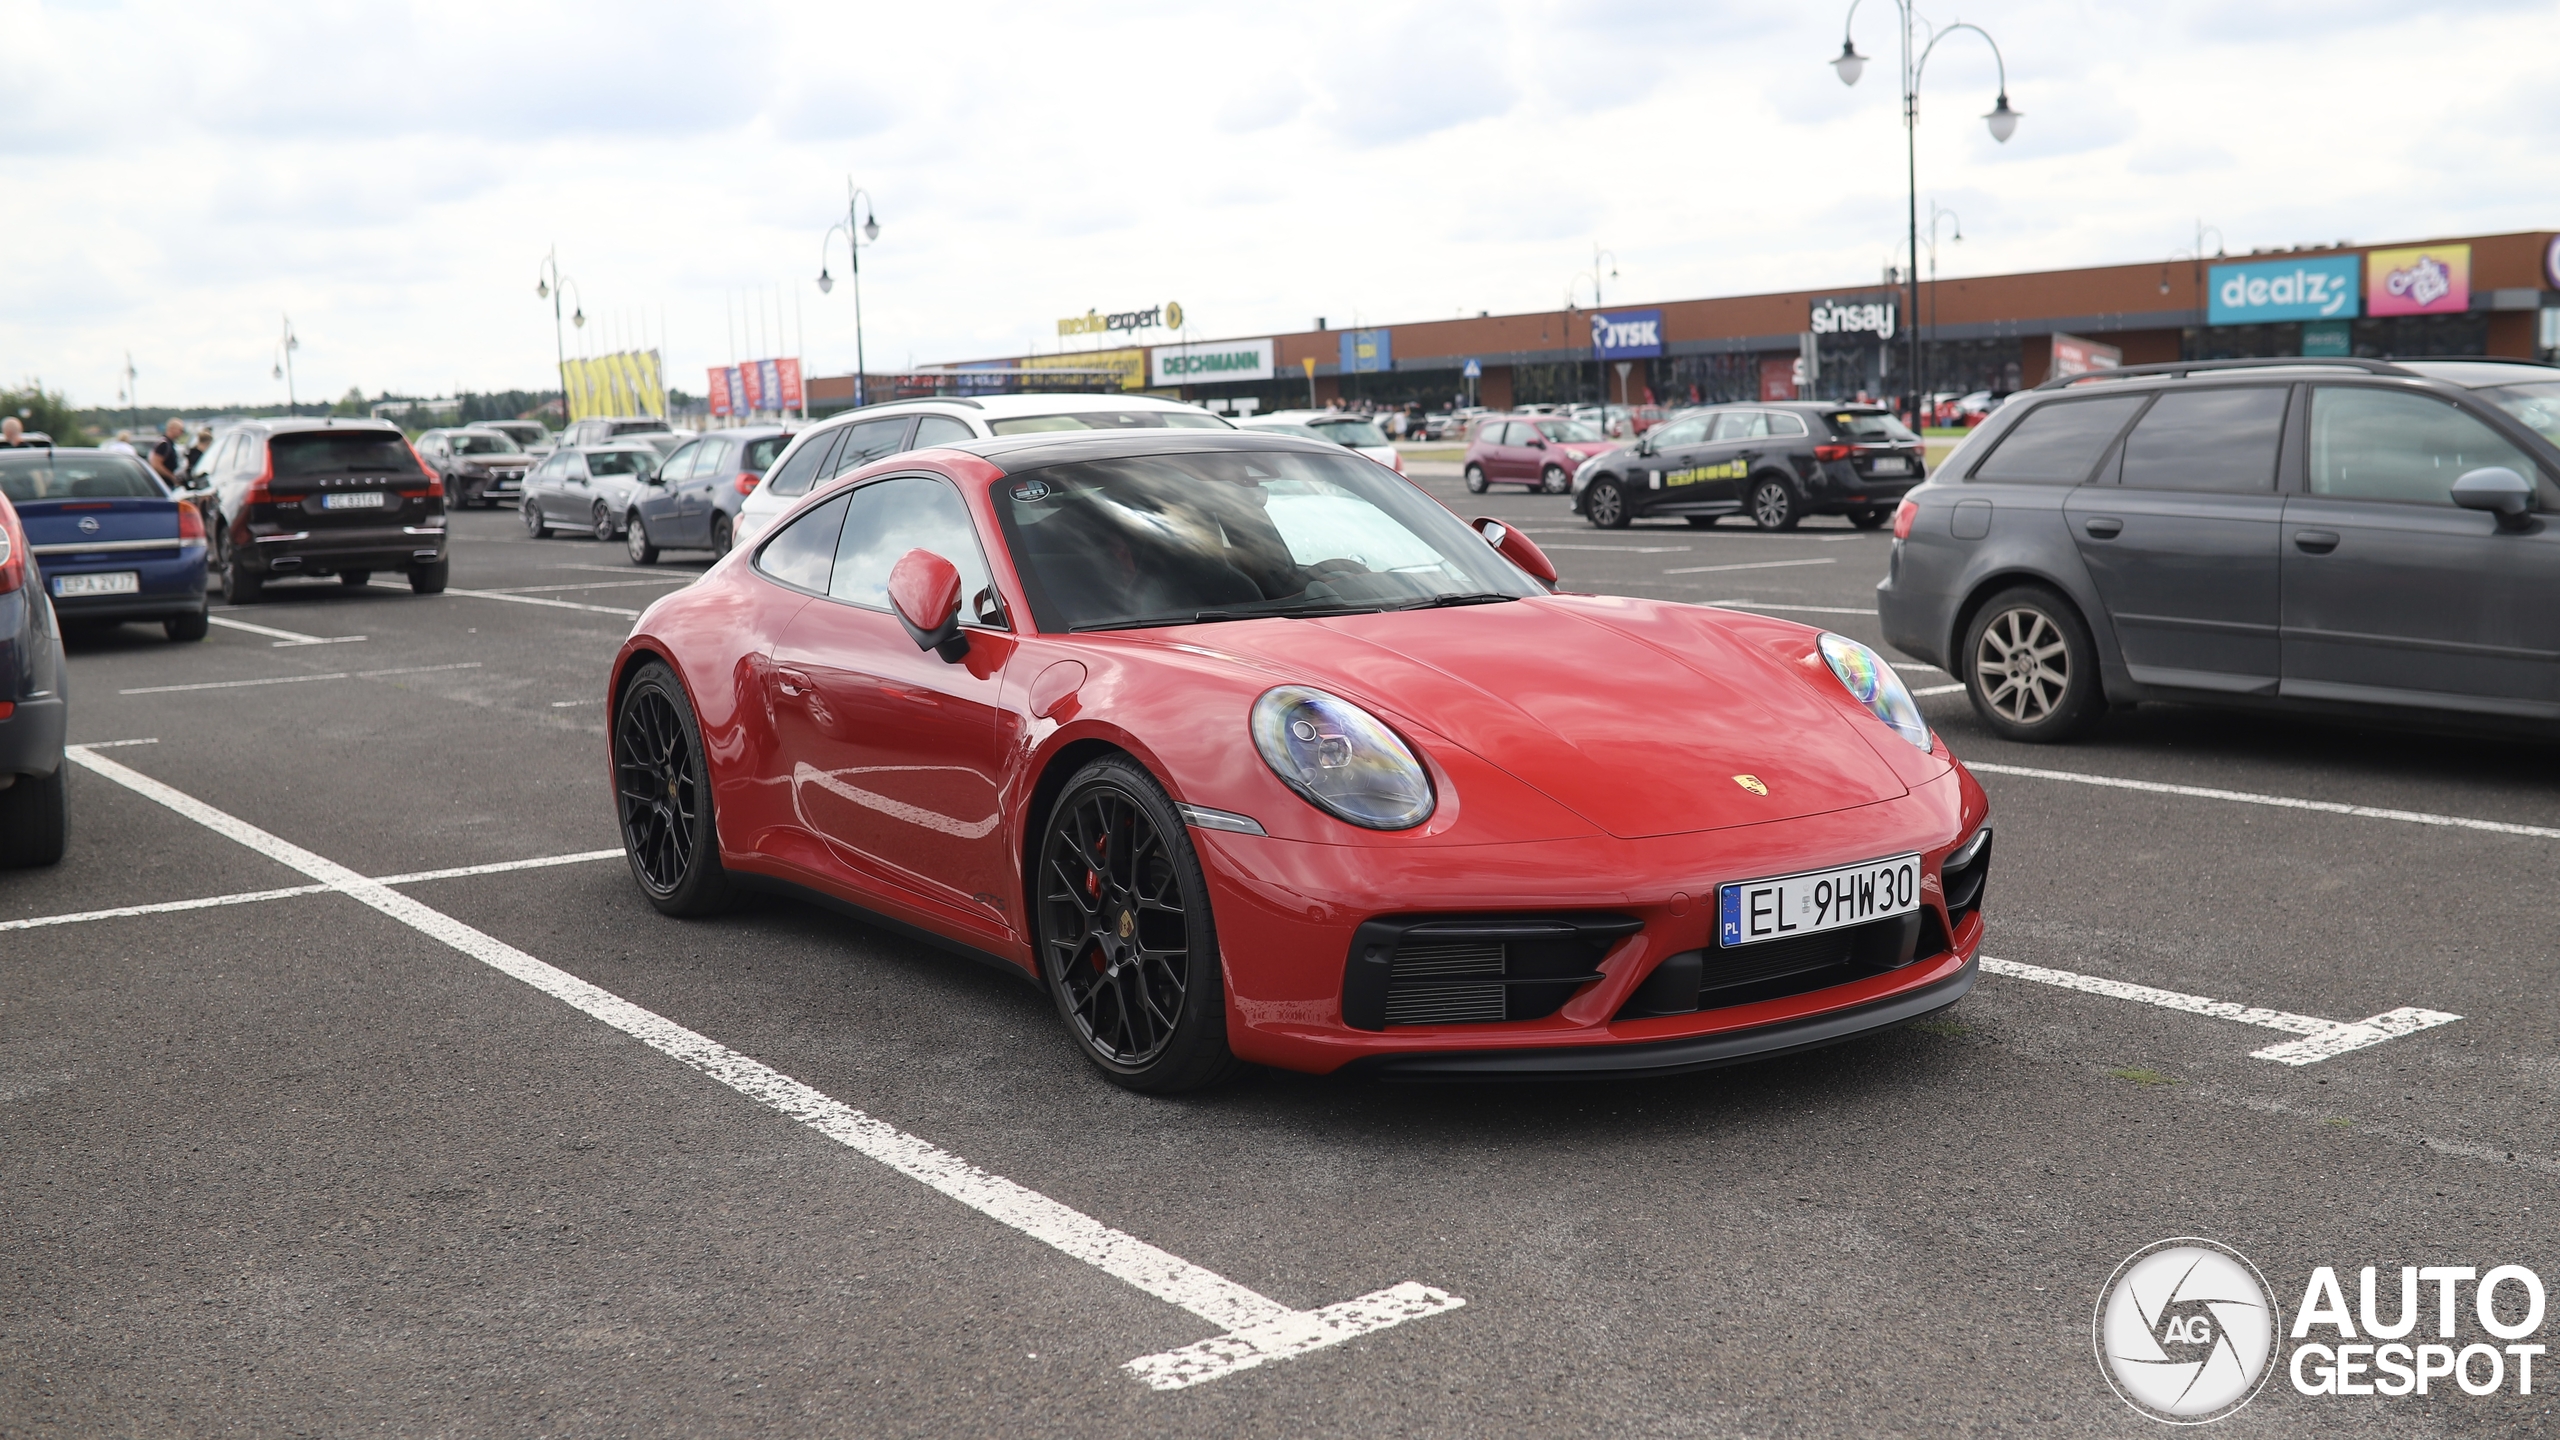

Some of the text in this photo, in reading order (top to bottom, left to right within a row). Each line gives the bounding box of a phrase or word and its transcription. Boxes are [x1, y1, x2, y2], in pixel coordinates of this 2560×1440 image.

[2220, 268, 2330, 308] dealz
[1811, 299, 1895, 340] sinsay
[1604, 320, 1660, 349] JYSK
[65, 577, 95, 593] EPA
[973, 892, 1006, 911] GTS
[1751, 863, 1913, 936] EL 9HW30
[1725, 922, 1739, 936] PL
